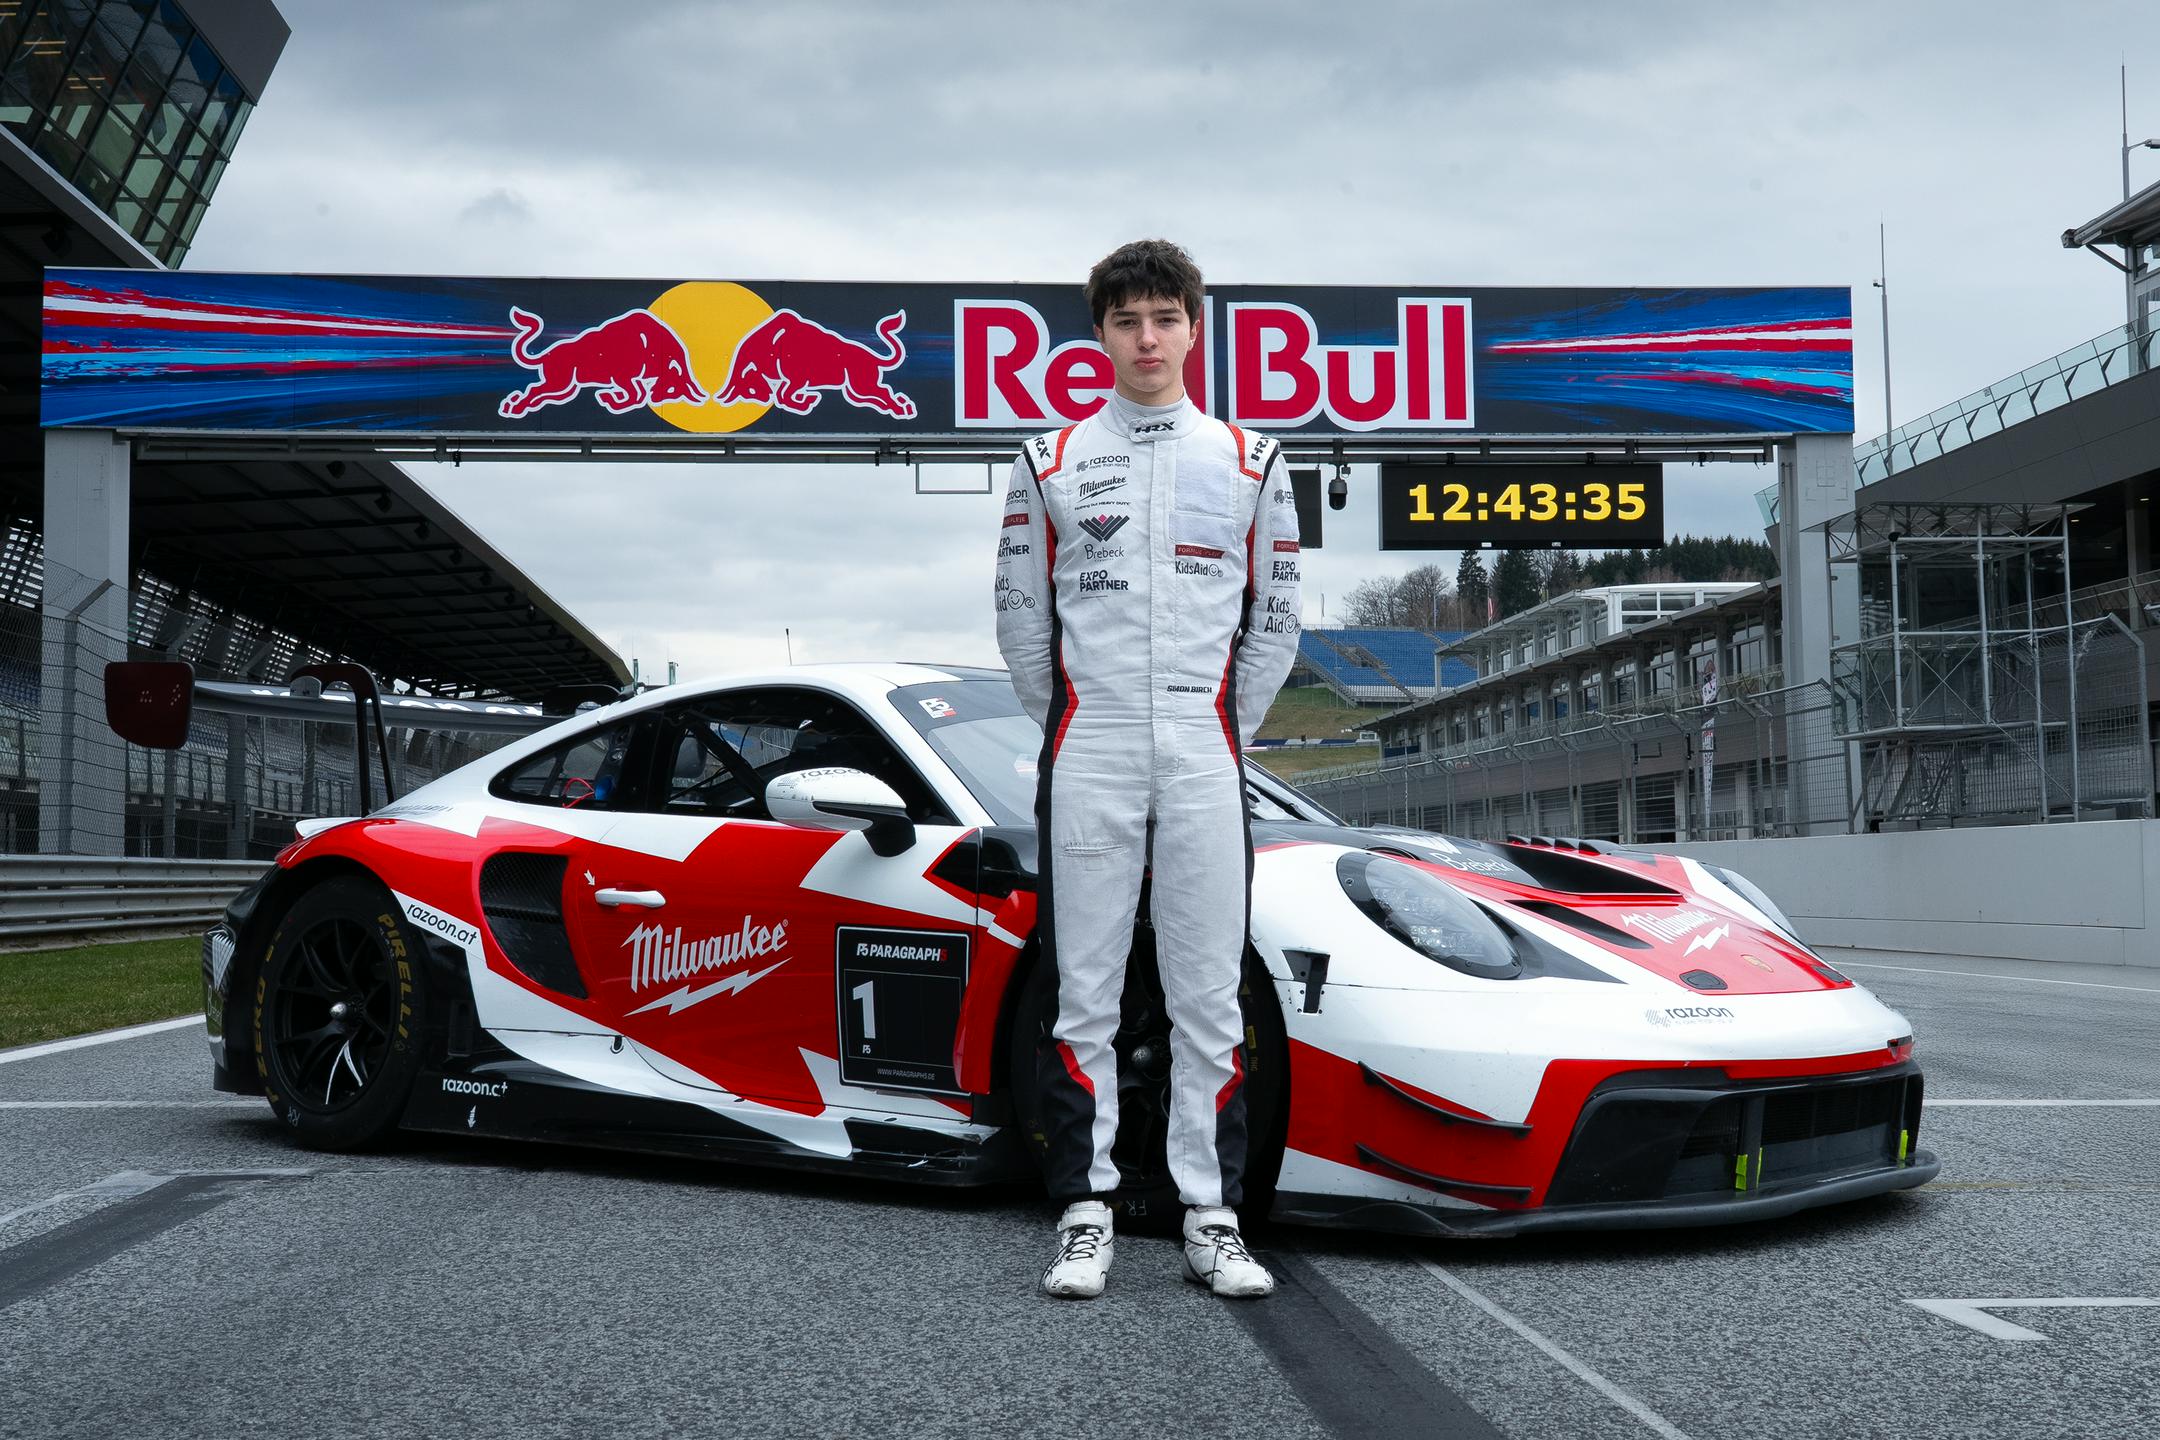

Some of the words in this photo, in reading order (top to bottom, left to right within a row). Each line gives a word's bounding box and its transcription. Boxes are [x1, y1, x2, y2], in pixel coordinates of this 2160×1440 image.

[1234, 305, 1467, 422] Bull
[1134, 421, 1175, 433] HRX
[1089, 455, 1130, 465] razoon
[1078, 476, 1126, 497] Milwaukee
[1408, 483, 1646, 521] 12:43:35
[1084, 544, 1125, 559] Brebeck
[1273, 561, 1296, 571] EXPO
[1080, 570, 1108, 581] EXPO
[1080, 580, 1129, 592] PARTNER
[1267, 596, 1290, 614] Kids
[1264, 615, 1284, 633] Aid
[1428, 852, 1514, 871] Brebeck
[406, 902, 477, 946] razoon.at
[1620, 906, 1717, 945] Milwaukee
[620, 914, 789, 994] Milwaukee
[378, 912, 413, 1040] PIRELLI
[852, 980, 876, 1039] 1
[1664, 1007, 1735, 1019] razoon
